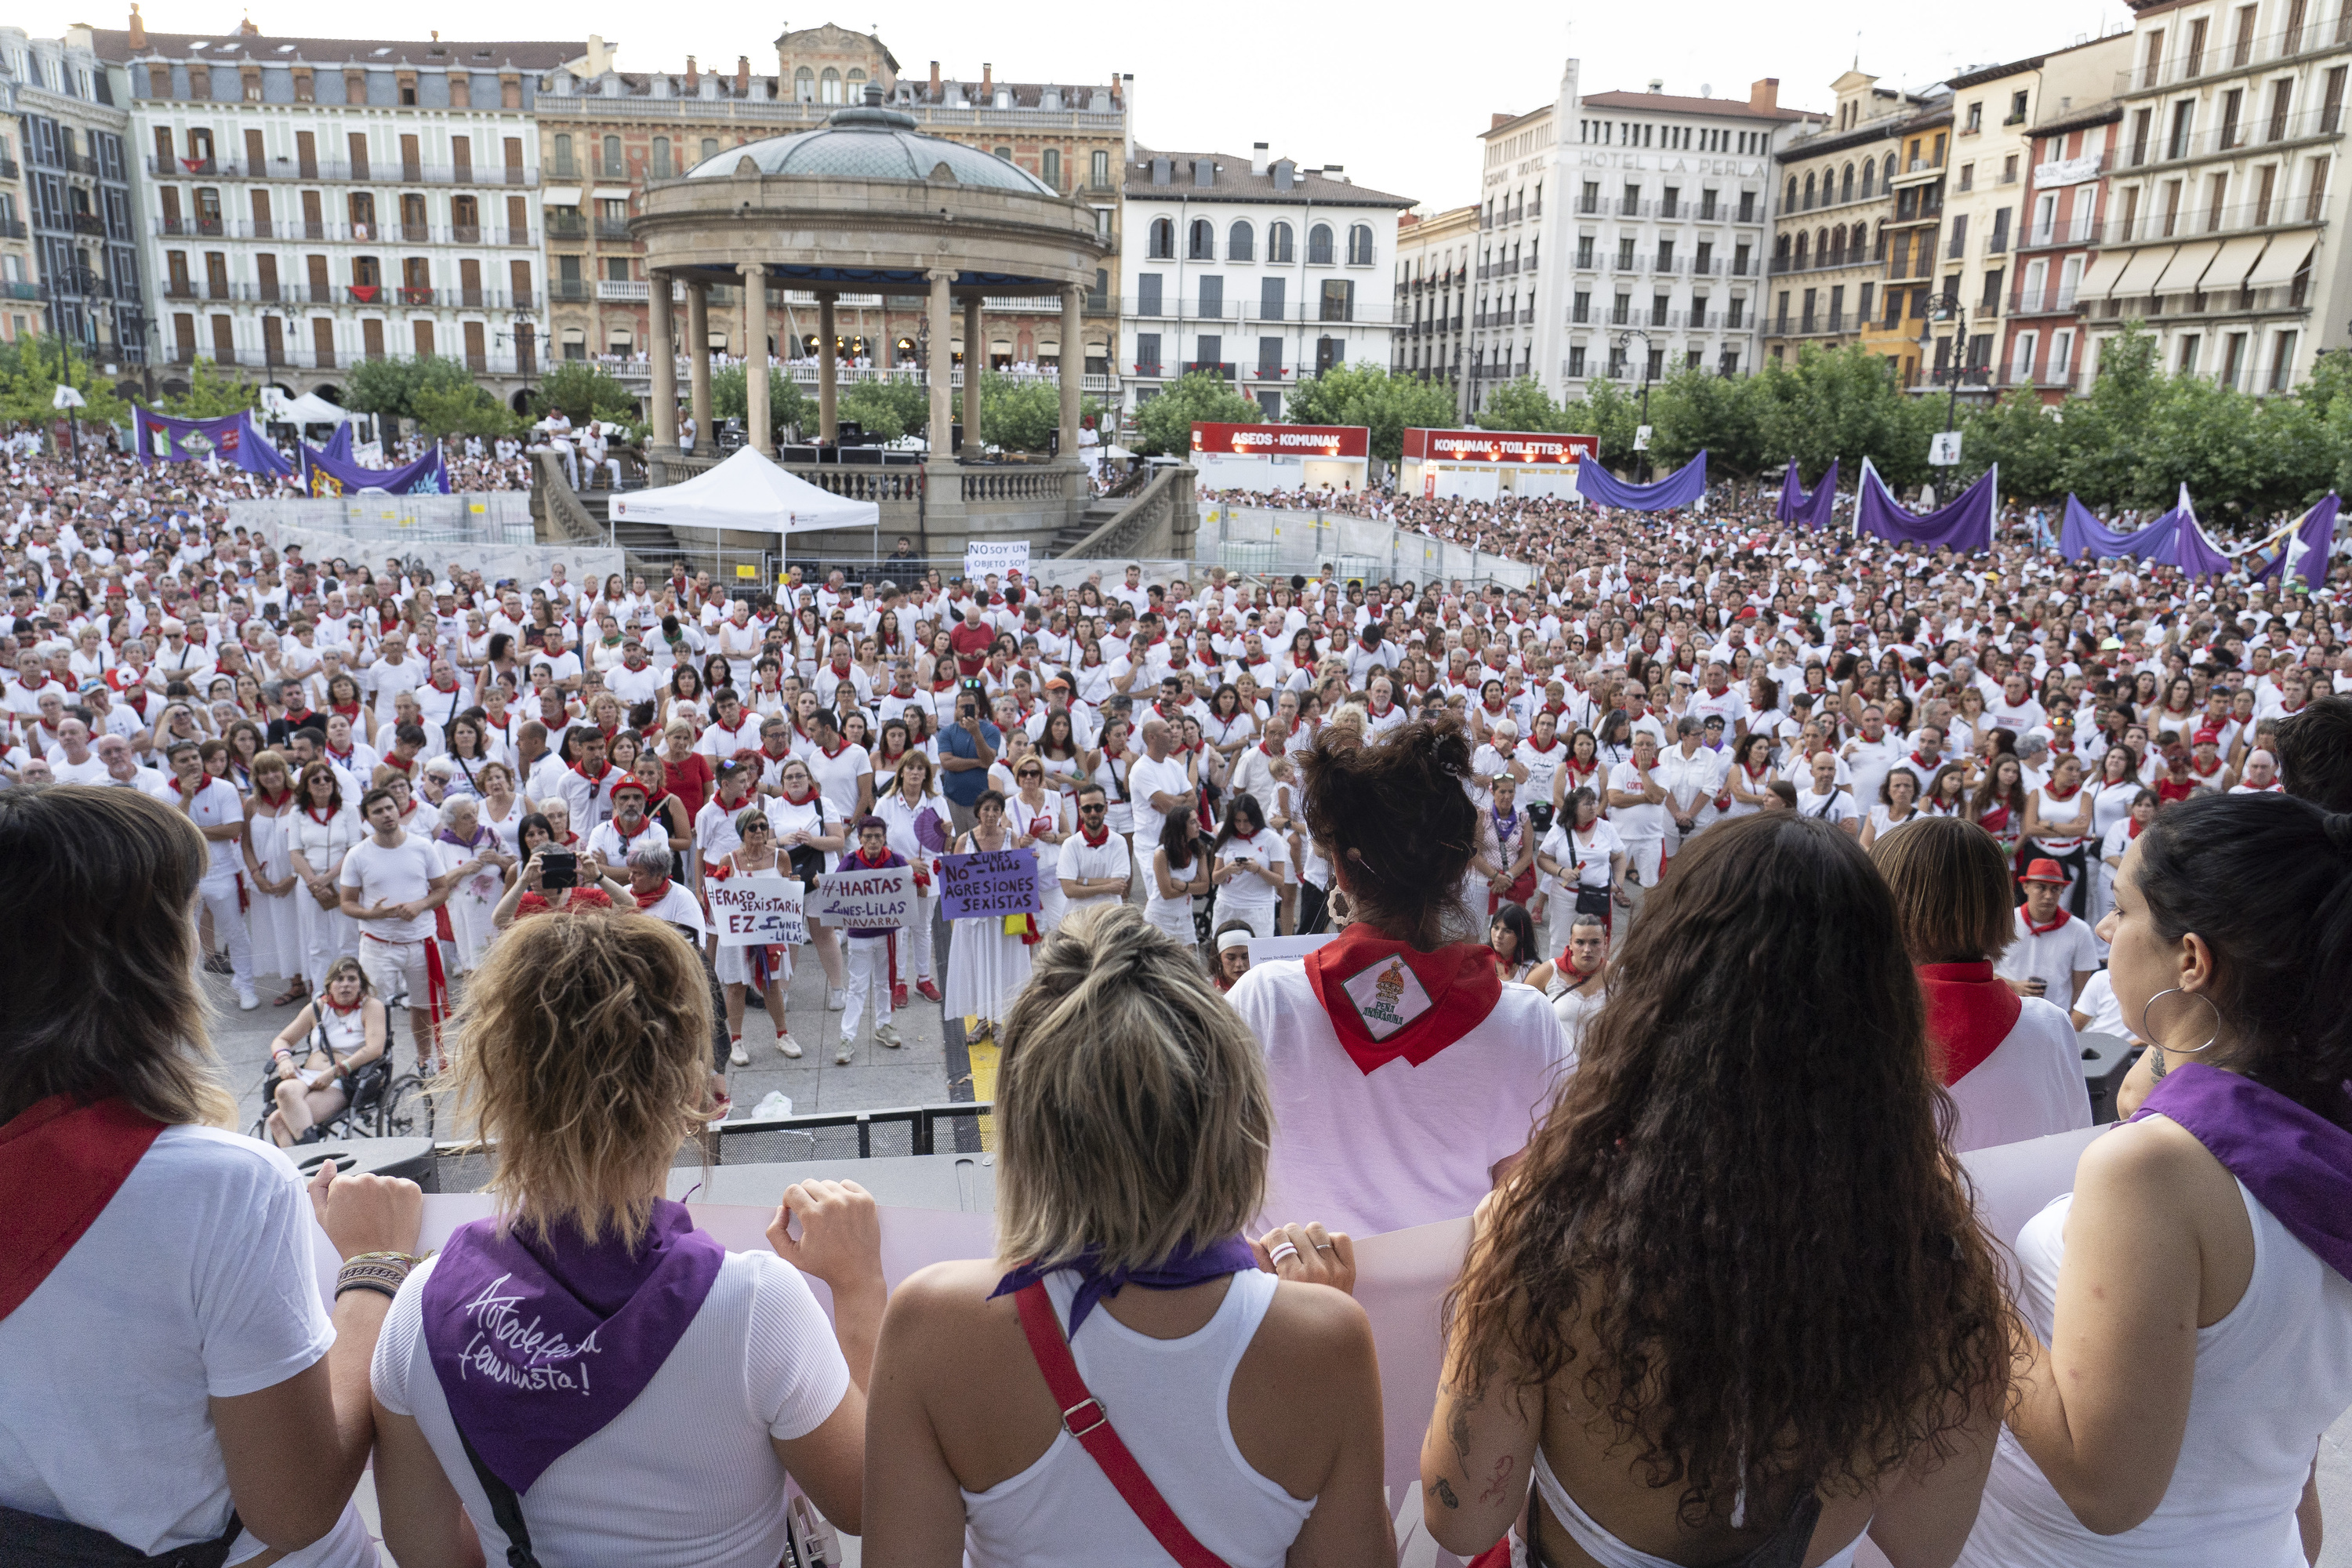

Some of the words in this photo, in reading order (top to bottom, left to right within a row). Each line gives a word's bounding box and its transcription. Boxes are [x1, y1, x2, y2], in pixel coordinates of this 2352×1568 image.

[1580, 151, 1647, 170] HOTEL
[1659, 157, 1687, 172] LA
[1698, 159, 1766, 177] PERLA
[1231, 431, 1273, 445] ASEOS
[1279, 434, 1341, 448] KOMUNAK
[1434, 439, 1493, 452] KOMUNAK
[1499, 441, 1563, 455] TOILETTES
[970, 545, 988, 554] NO
[974, 560, 1006, 568] OBJETO
[946, 865, 969, 883] NO
[843, 917, 900, 927] NAVARRA
[458, 1330, 590, 1396] feminista!
